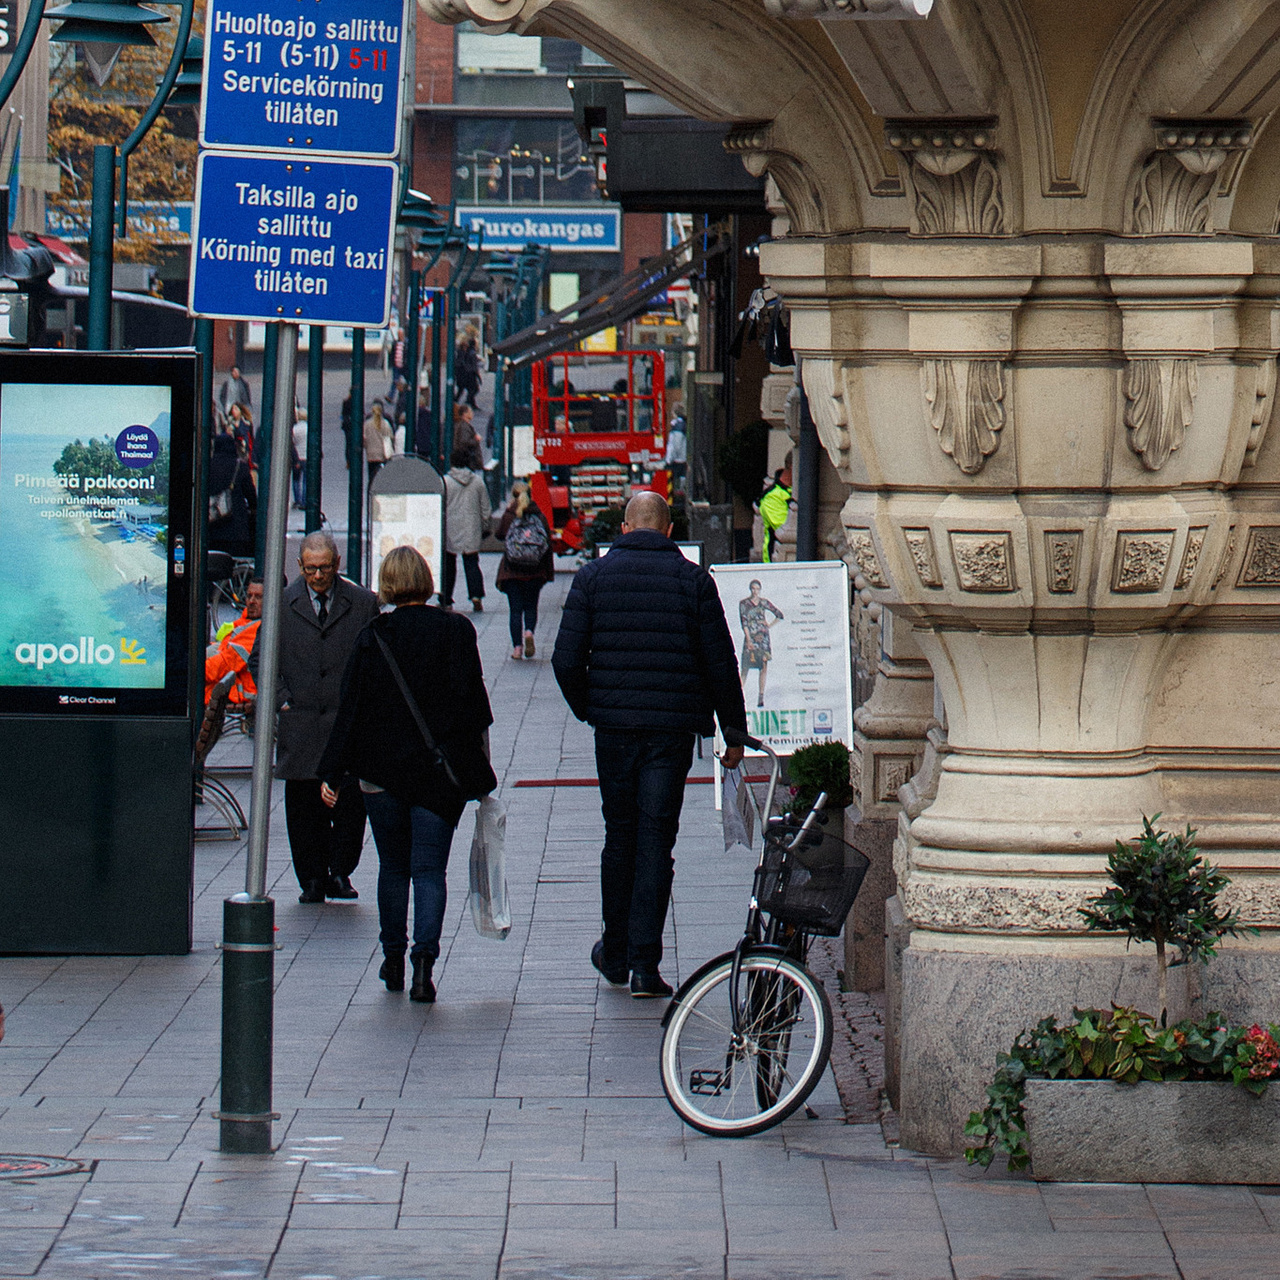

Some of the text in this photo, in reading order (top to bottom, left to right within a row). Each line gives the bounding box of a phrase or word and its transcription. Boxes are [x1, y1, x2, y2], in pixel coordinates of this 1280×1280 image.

[215, 11, 399, 44] Huoltoajo sallittu
[223, 40, 388, 71] 5-11 (5-11) 5-11
[223, 70, 384, 104] Servicekörning
[265, 100, 339, 127] tillåten
[235, 182, 359, 215] Taksilla ajo
[257, 214, 332, 238] sallittu
[200, 237, 385, 270] Körning med taxi
[254, 269, 328, 295] tillåten
[14, 473, 156, 492] Pimeää pakoon!
[40, 509, 127, 520] apollomatkat.fi
[15, 636, 115, 670] apollo
[69, 696, 117, 704] Clear Channel
[746, 709, 807, 736] MINETT
